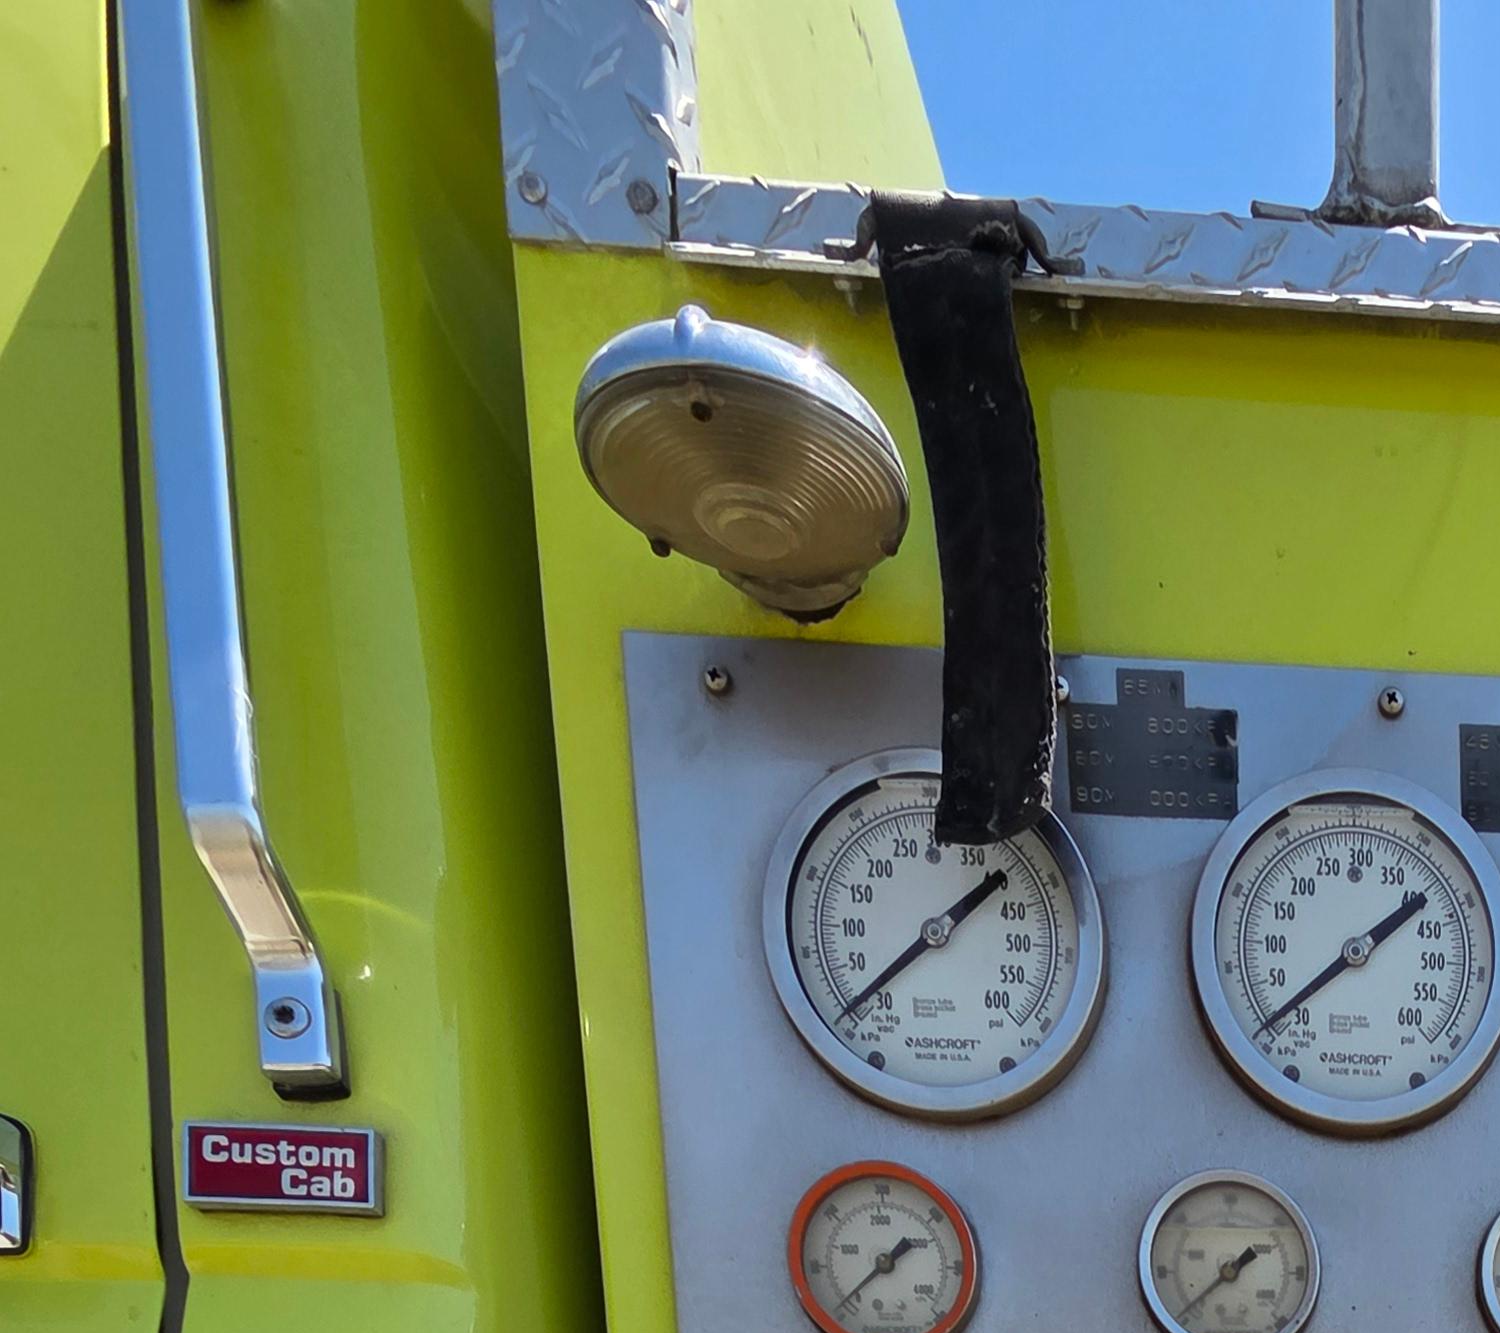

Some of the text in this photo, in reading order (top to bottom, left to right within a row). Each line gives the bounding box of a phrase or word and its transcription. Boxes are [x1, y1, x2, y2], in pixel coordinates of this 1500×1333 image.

[893, 838, 918, 858] 250
[959, 847, 985, 866] 350
[1348, 848, 1374, 867] 300
[867, 859, 893, 878] 200
[1315, 857, 1341, 877] 250
[1380, 865, 1405, 885] 350
[849, 884, 873, 903] 150
[1290, 876, 1316, 896] 200
[1000, 902, 1026, 920] 450
[1273, 900, 1296, 920] 150
[841, 918, 866, 937] 100
[1416, 920, 1442, 939] 450
[1005, 934, 1031, 952] 500
[1264, 934, 1287, 953] 100
[848, 952, 866, 971] 50
[1420, 951, 1446, 970] 500
[999, 965, 1025, 984] 550
[1268, 967, 1287, 986] 50
[875, 991, 893, 1010] 30
[984, 989, 1010, 1009] 600
[1413, 982, 1438, 1001] 550
[1293, 1006, 1310, 1025] 30
[1397, 1007, 1423, 1026] 600
[914, 1036, 977, 1051] ASHCROFT
[1328, 1051, 1390, 1067] ASHCROFT
[201, 1133, 356, 1169] Custom
[280, 1167, 356, 1198] Cab
